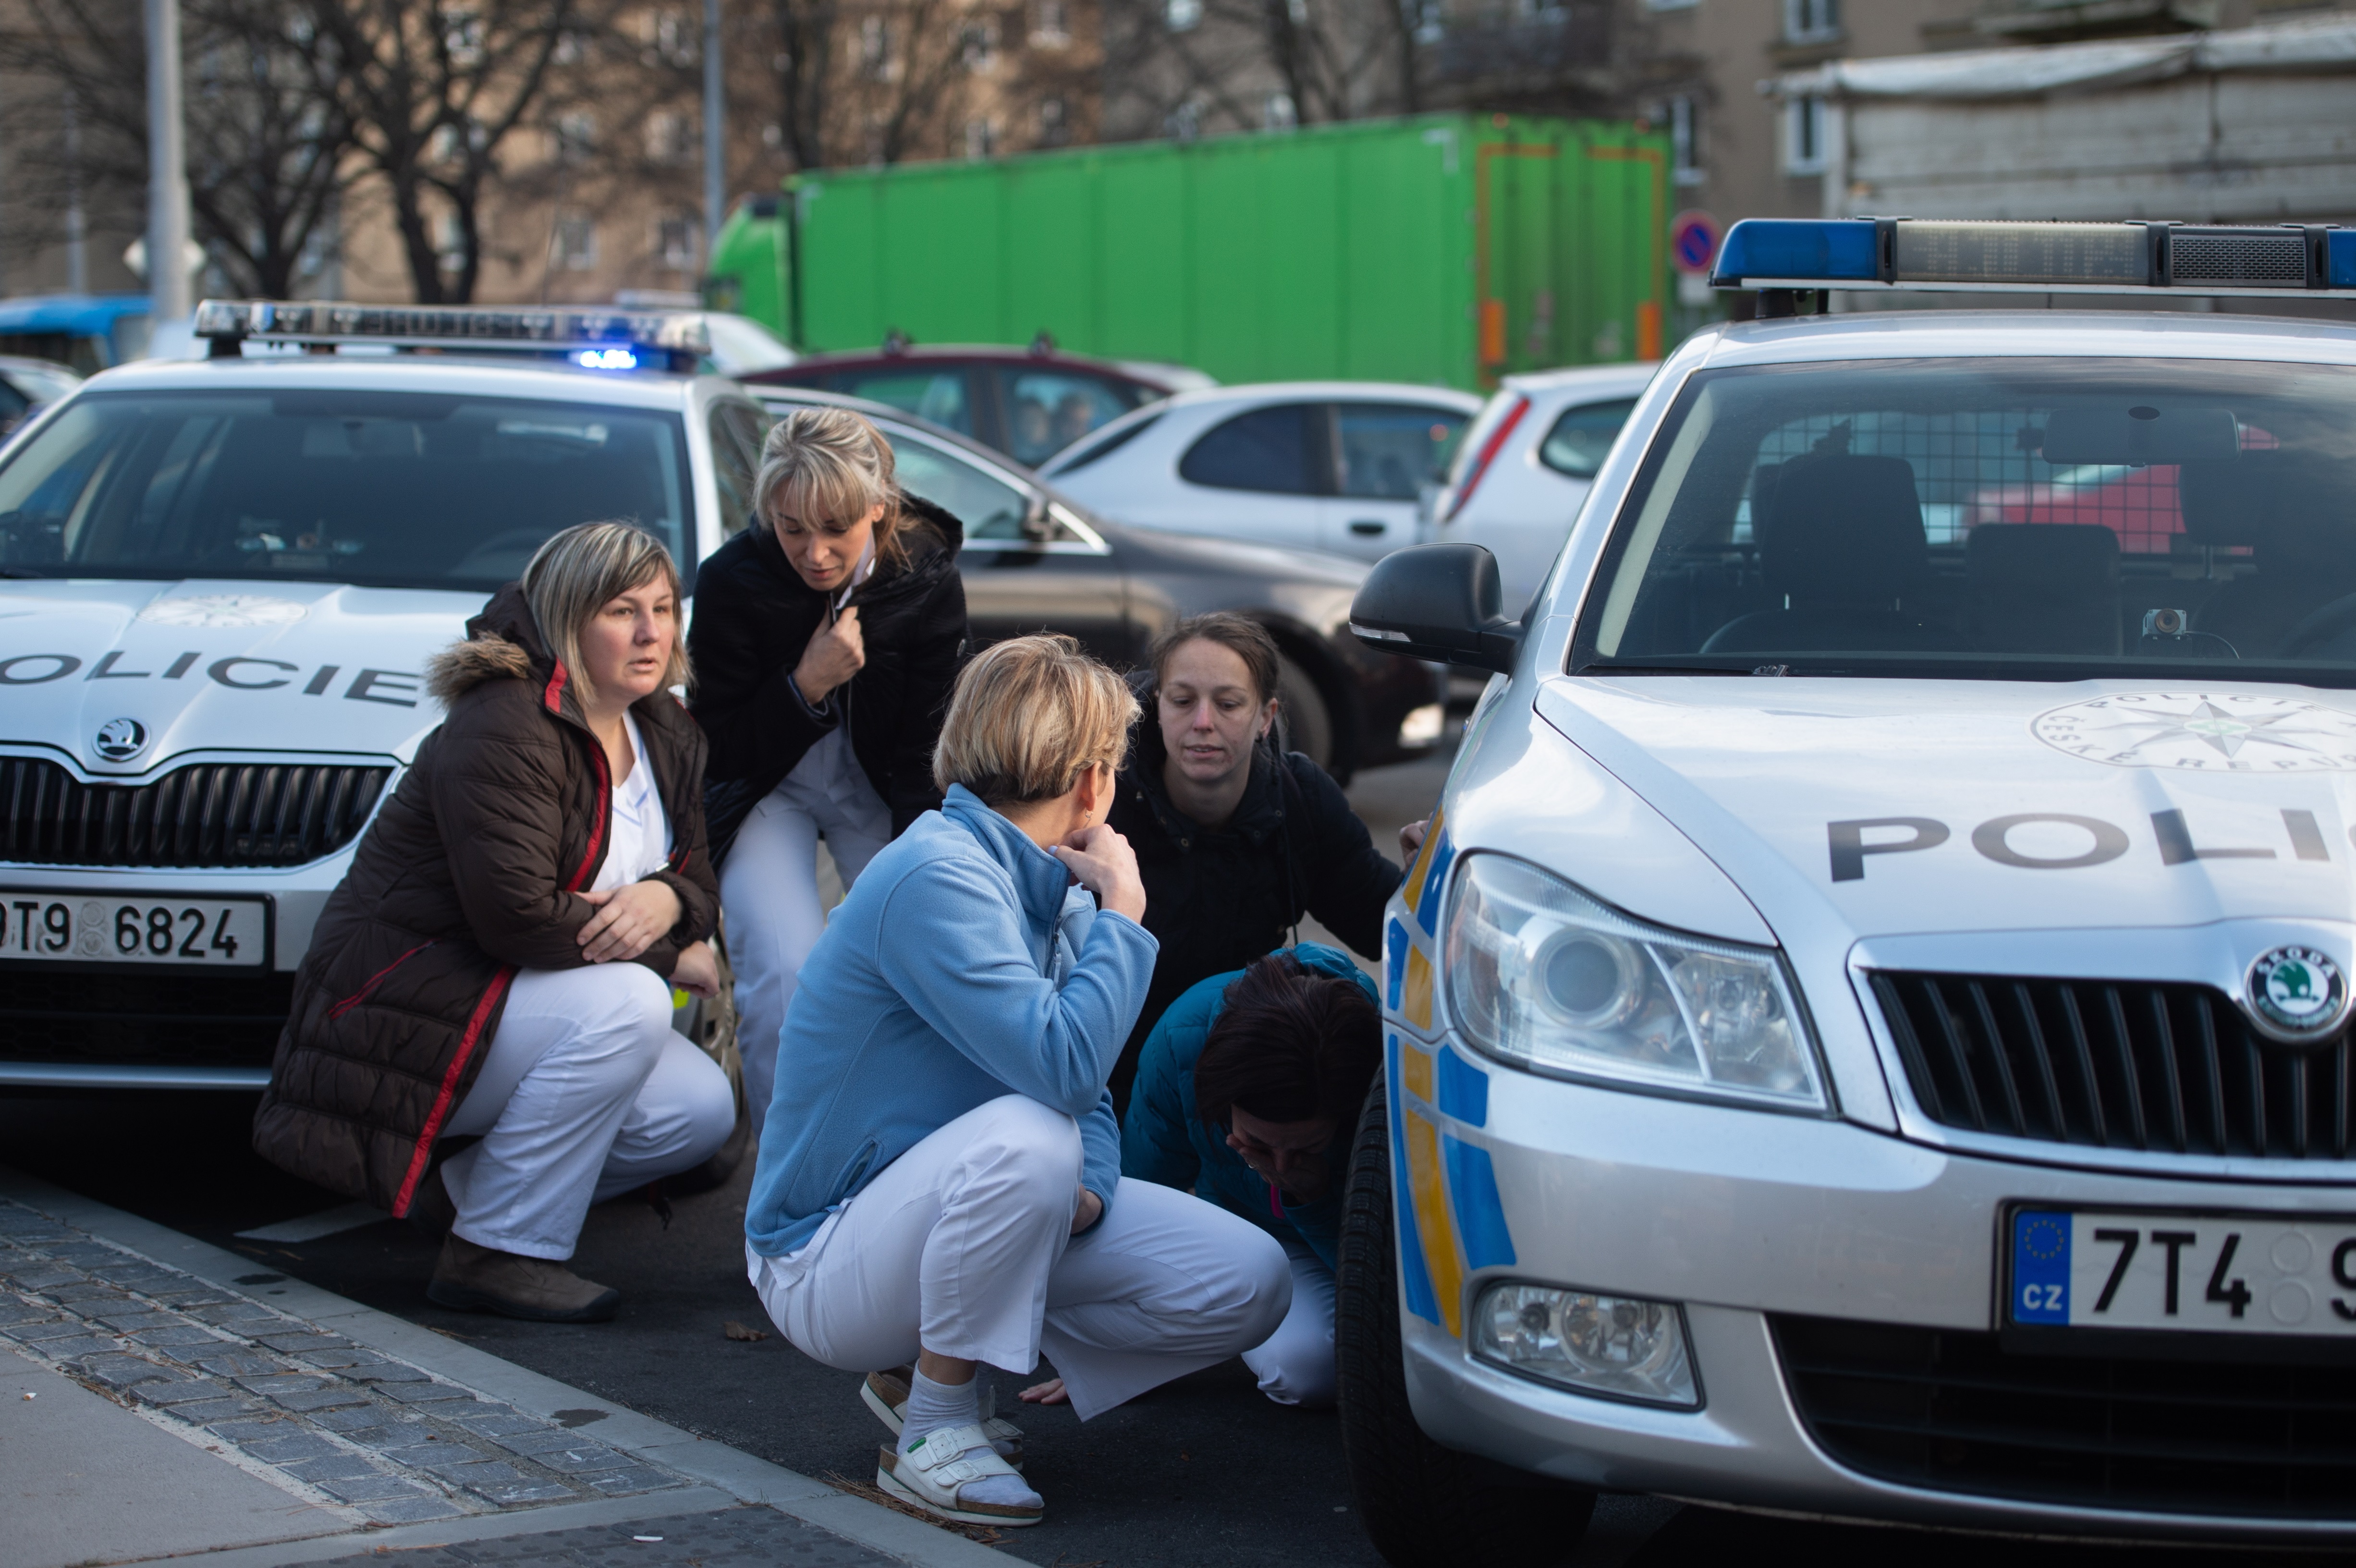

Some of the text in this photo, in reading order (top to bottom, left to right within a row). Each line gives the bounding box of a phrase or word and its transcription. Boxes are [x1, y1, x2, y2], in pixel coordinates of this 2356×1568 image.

[1827, 809, 2356, 883] POLI
[0, 901, 238, 958] T9 6824
[2023, 1284, 2063, 1311] CZ
[2093, 1228, 2252, 1319] 7T4
